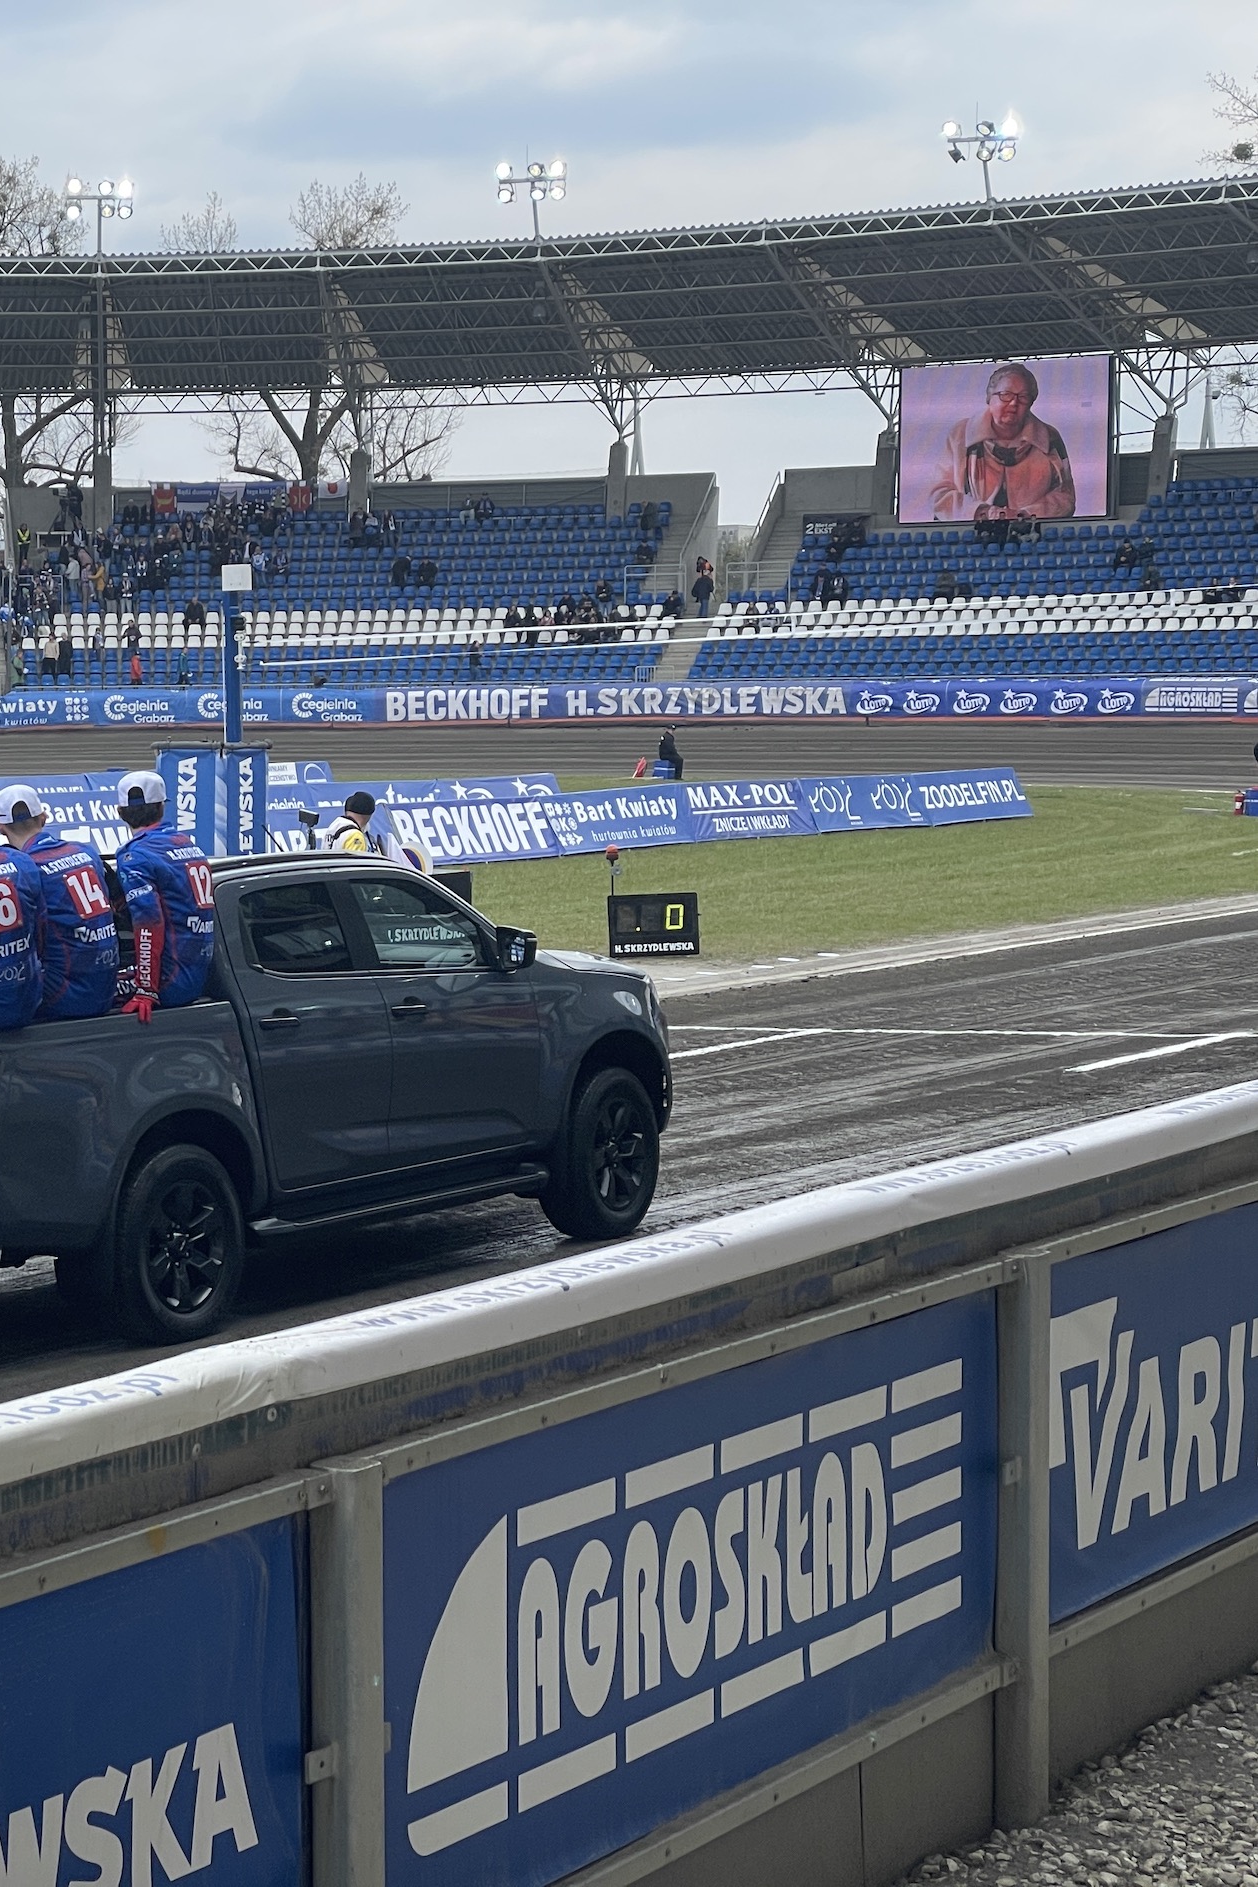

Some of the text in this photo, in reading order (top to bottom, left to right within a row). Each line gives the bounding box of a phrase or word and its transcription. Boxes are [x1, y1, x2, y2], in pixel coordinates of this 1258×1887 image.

[386, 687, 549, 722] BECKHOFF
[566, 685, 847, 717] H.SKRZYDLEWSKA
[863, 696, 888, 711] LOTTO
[910, 696, 935, 711] LOTTO
[960, 696, 984, 711] LOTTO
[1007, 695, 1031, 710] LOTTO
[1059, 696, 1082, 710] LOTTO
[1105, 695, 1129, 709] LOTTO
[1159, 690, 1223, 708] AGROSKŁAD
[4, 716, 48, 726] kwiatów
[133, 714, 175, 724] Grabarz
[321, 710, 363, 722] Grabarz
[919, 779, 1027, 809] ZOODELFIN.PL
[574, 796, 678, 823] Bart Kwiaty
[393, 801, 550, 857] BECKHOFF
[713, 817, 746, 833] ZNICZE
[751, 815, 791, 831] WKŁADY
[591, 825, 677, 843] hurtownia kwiatów
[66, 870, 110, 915] 14
[189, 864, 215, 906] 12
[351, 1229, 734, 1330] www.skrzydlewska.pl
[516, 1441, 888, 1747] AGROSKŁAD
